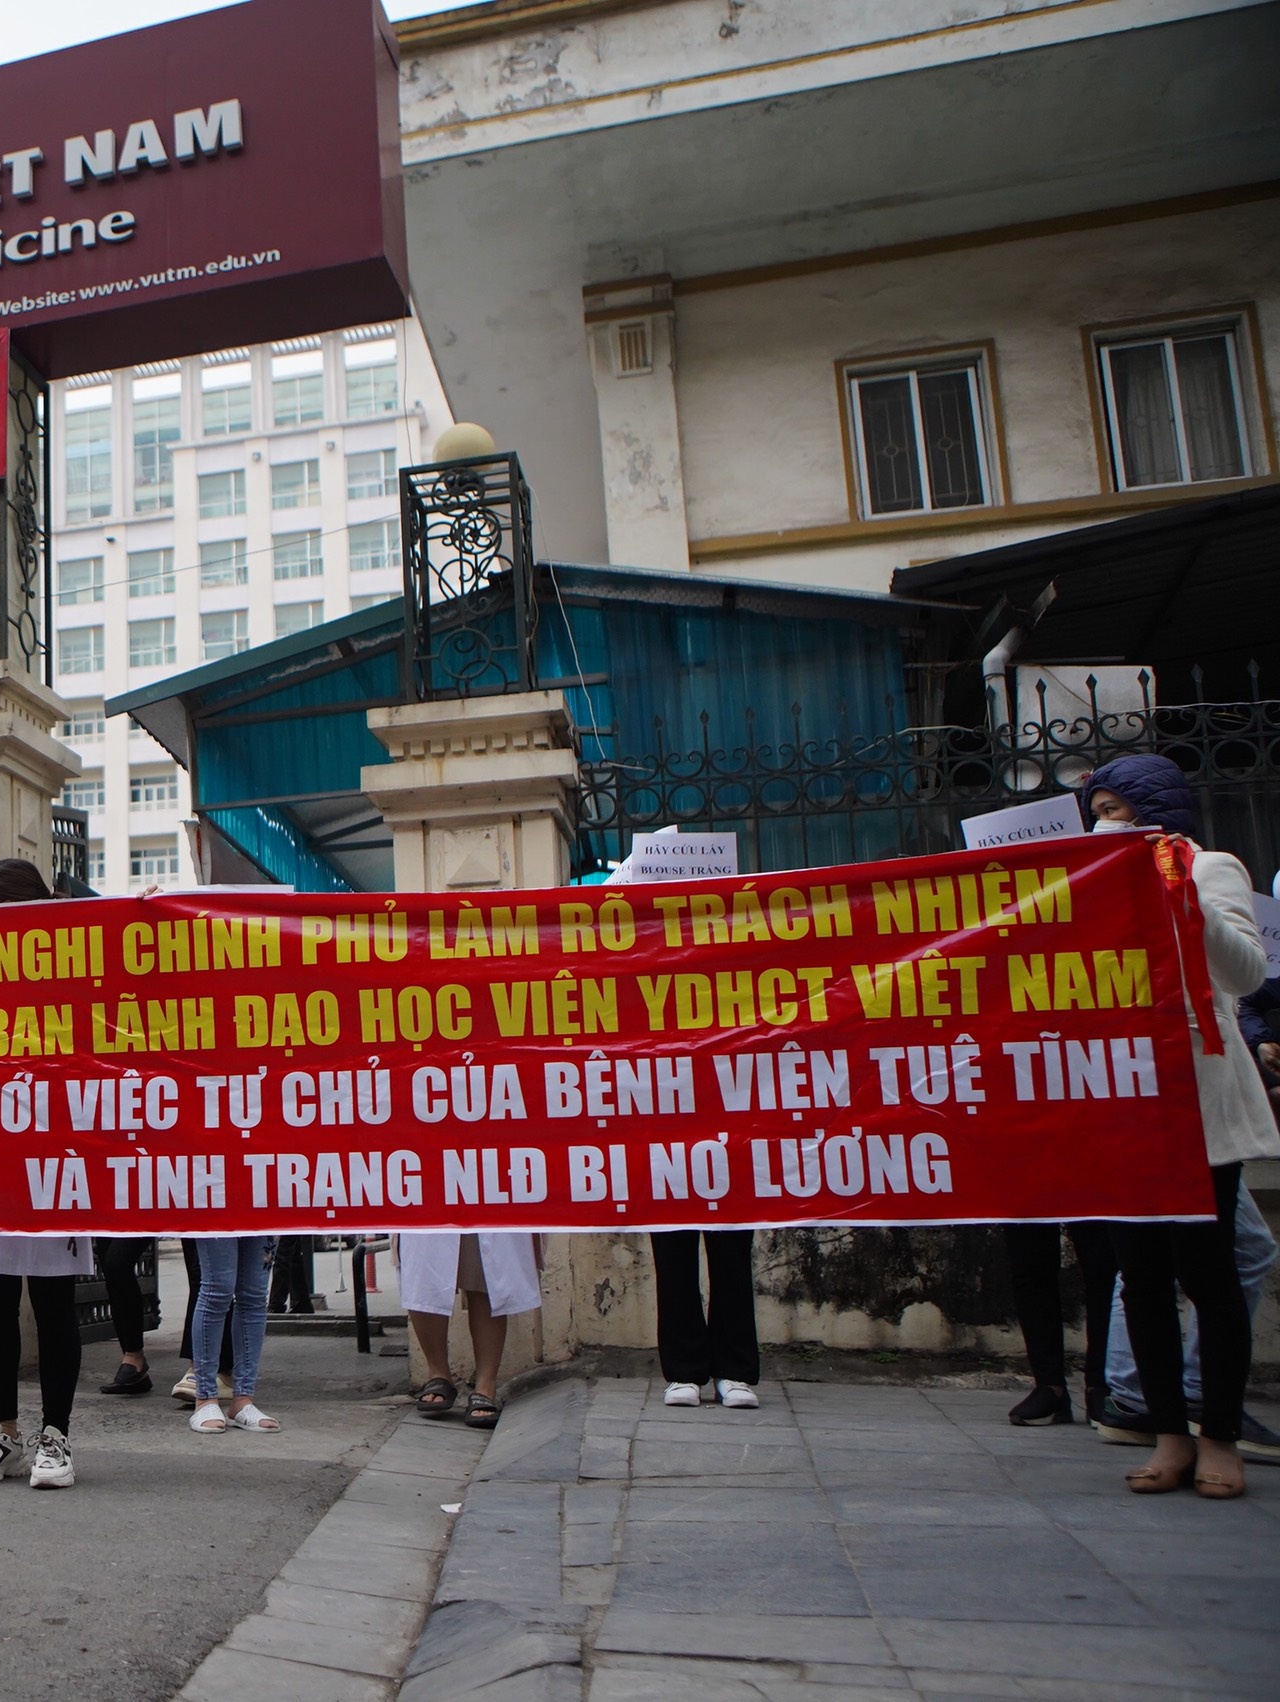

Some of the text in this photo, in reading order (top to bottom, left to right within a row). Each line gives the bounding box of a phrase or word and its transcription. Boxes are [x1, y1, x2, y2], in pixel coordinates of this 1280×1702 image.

[64, 98, 244, 187] NAM
[79, 247, 283, 300] www.vutm.edu.vn
[641, 866, 686, 875] BLOUSE
[121, 911, 281, 976] CHÍNH
[301, 899, 407, 965] PHỦ
[428, 900, 538, 960] LÀM
[560, 893, 636, 956] RÕ
[653, 880, 854, 948] TRÁCH
[870, 861, 1074, 940] NHIỆM
[91, 992, 215, 1057] LÃNH
[232, 990, 341, 1058] ĐẠO
[358, 983, 472, 1052] HỌC
[489, 969, 619, 1046] VIỆN
[635, 966, 834, 1032] YDHCT
[850, 949, 987, 1029] VIỆT
[1007, 949, 1154, 1013] NAM
[65, 1068, 179, 1141] VIỆC
[196, 1065, 267, 1139] TỰ
[281, 1055, 392, 1125] CHỦ
[411, 1051, 527, 1124] CỦA
[544, 1049, 696, 1129] BỆNH
[713, 1041, 852, 1121] VIỆN
[870, 1033, 987, 1115] TUỆ
[1003, 1031, 1160, 1102] TĨNH
[25, 1126, 954, 1218] VÀ TÌNH TRẠNG NLĐ BỊ NỢ LƯƠNG
